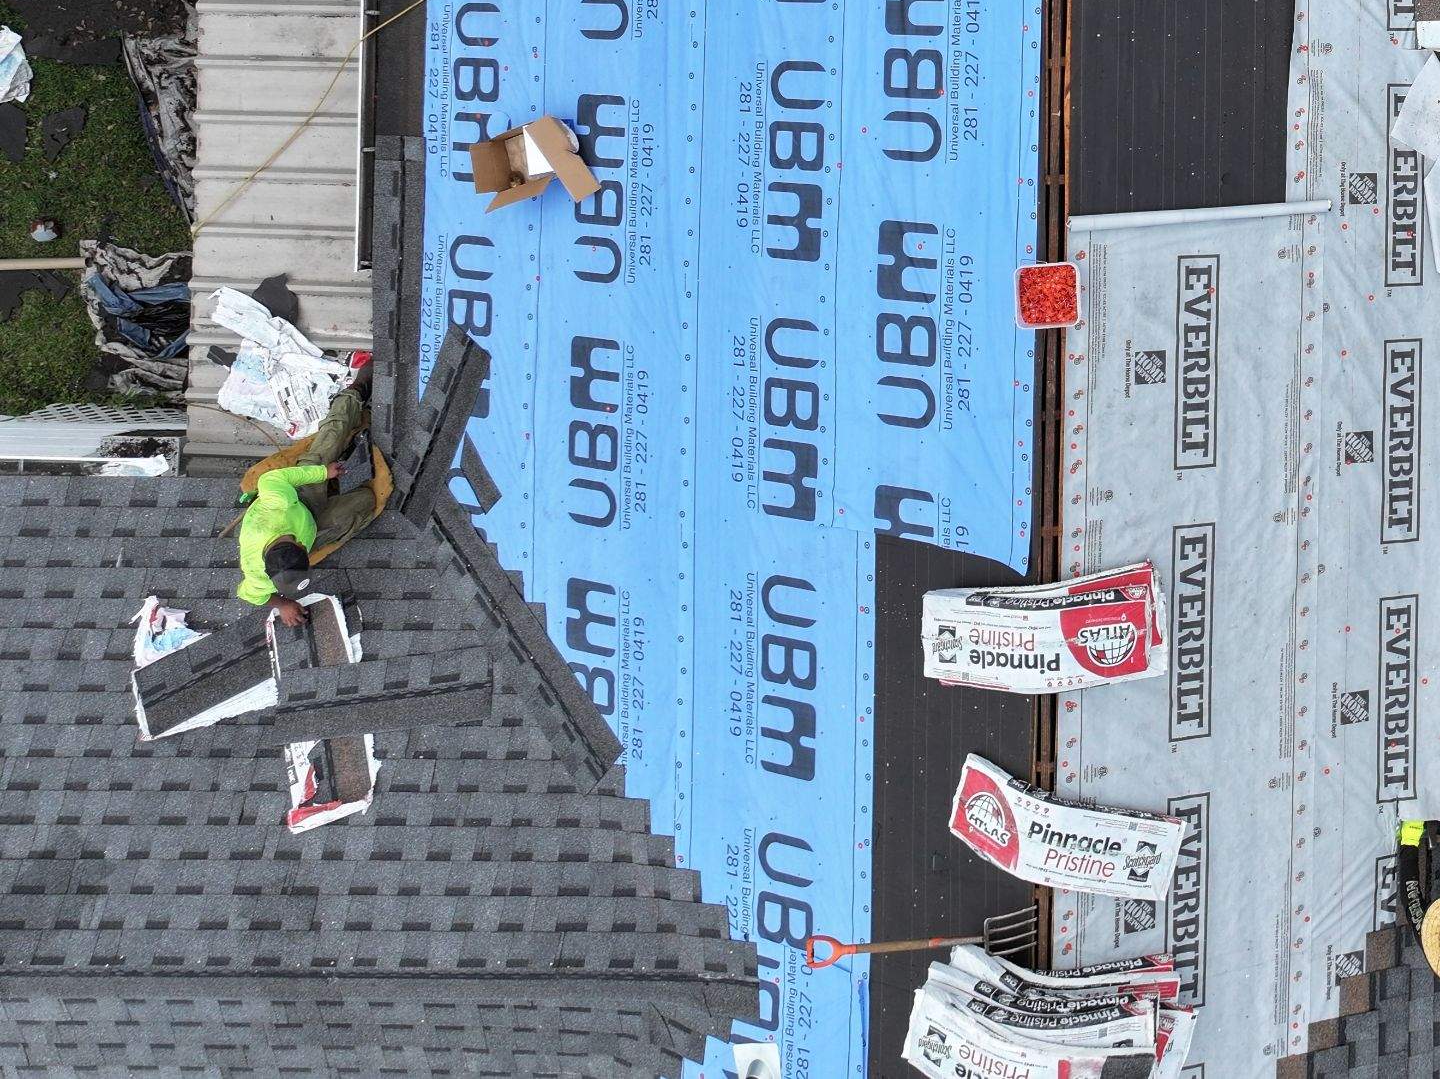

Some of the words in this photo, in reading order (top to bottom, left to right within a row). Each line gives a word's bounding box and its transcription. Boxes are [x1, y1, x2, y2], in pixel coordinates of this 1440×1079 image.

[950, 50, 962, 99] Building
[964, 52, 979, 87] 227
[949, 103, 960, 161] Universal
[963, 107, 978, 141] 281
[1392, 93, 1418, 275] ERBILT
[733, 335, 745, 368] 281
[749, 317, 758, 373] Universal
[1150, 354, 1163, 368] THE
[1182, 265, 1214, 457] EVERBILT
[1135, 351, 1166, 383] HOME
[1135, 365, 1152, 384] DEPOT
[732, 388, 745, 421] 227
[746, 376, 758, 423] Building
[747, 426, 757, 481] Materials
[1388, 349, 1415, 532] EVERBILT
[731, 437, 744, 482] 0419
[747, 485, 755, 509] LLC
[1052, 590, 1115, 607] Pinnacle
[968, 628, 1035, 652] Pristine
[1078, 624, 1131, 644] ATLAS
[1177, 534, 1211, 732] EVERBILT
[968, 649, 1061, 674] Pinnacle
[1384, 605, 1411, 790] EVERBILT
[969, 814, 1009, 845] ATLAS
[1028, 821, 1122, 856] Pinnacle
[1043, 848, 1116, 878] Pristine
[1082, 957, 1143, 975] Pinnacle
[979, 982, 993, 995] OK
[1065, 994, 1130, 1013] Pinnacle
[970, 1002, 983, 1013] OK
[1009, 1014, 1057, 1027] Pristine
[1016, 998, 1065, 1013] Pristine
[1059, 1006, 1120, 1027] Pinnacle
